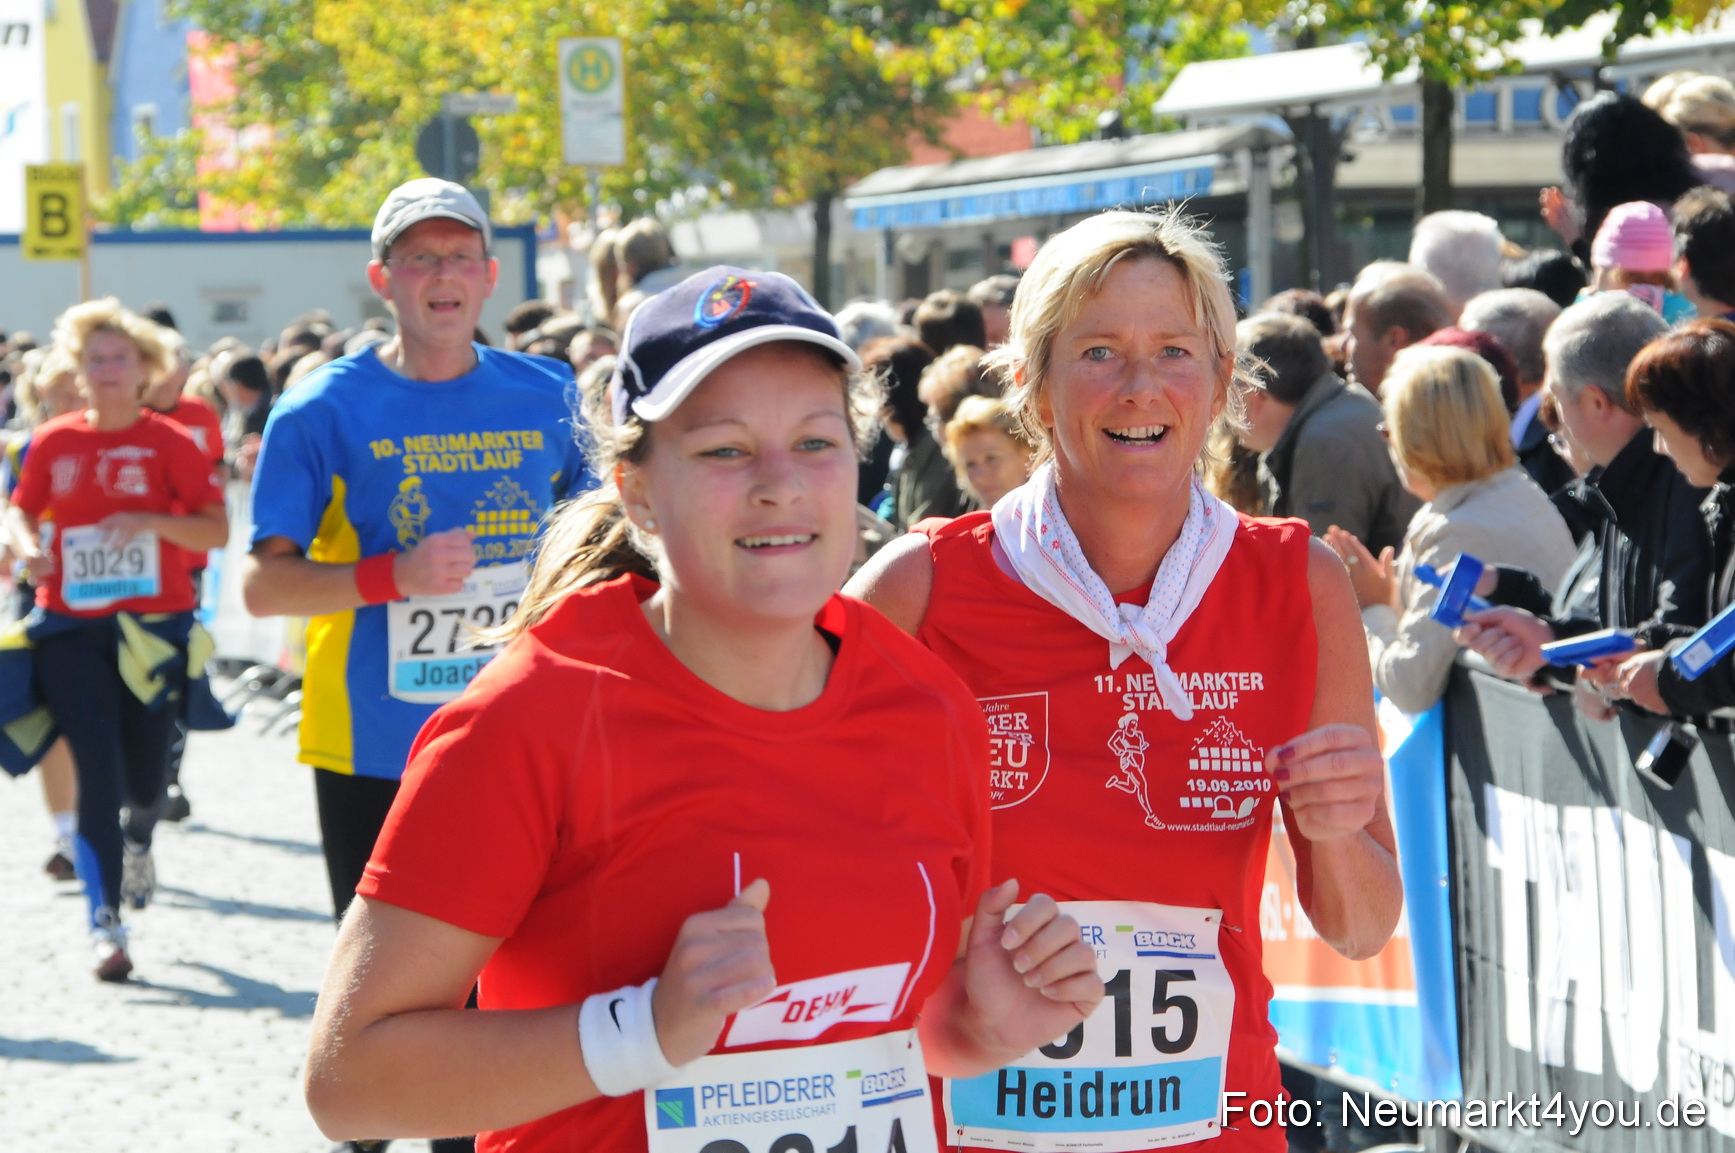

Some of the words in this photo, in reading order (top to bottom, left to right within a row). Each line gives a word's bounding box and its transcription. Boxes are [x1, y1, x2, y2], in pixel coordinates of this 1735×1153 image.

[38, 192, 72, 238] B
[369, 439, 401, 460] 10.
[402, 430, 545, 453] NEUMARKTER
[402, 450, 524, 474] STADTLAUF
[73, 548, 144, 579] 3029
[1094, 675, 1122, 693] 11.
[983, 702, 1010, 713] Jahre
[1122, 692, 1239, 711] STALAUF
[990, 738, 1031, 768] EU
[990, 770, 1029, 790] RKT
[1186, 778, 1272, 793] 19.09.2010
[1134, 931, 1196, 949] BOCK
[781, 984, 859, 1023] DEHN
[701, 1073, 836, 1110] PFLEIDERER
[861, 1067, 907, 1095] BOCK
[996, 1068, 1181, 1119] Heidrun
[702, 1102, 837, 1128] AKTIENGESELLSCHAFT
